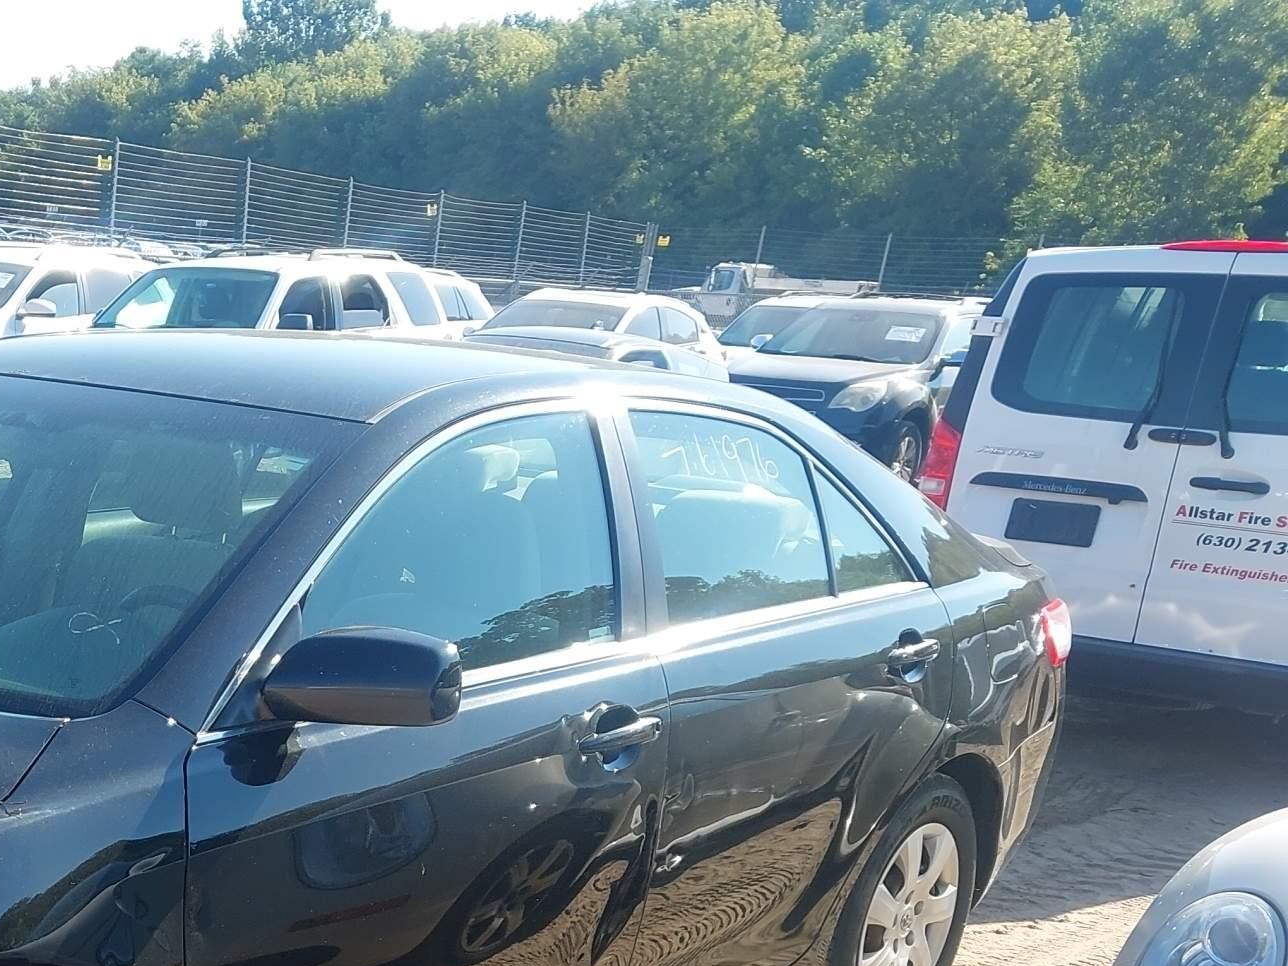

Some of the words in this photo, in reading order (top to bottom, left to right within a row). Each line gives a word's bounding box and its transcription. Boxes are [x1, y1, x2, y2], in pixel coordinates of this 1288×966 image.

[1175, 504, 1234, 522] Allstar
[1237, 511, 1272, 526] Fire
[1196, 533, 1242, 551] (630)
[1244, 538, 1288, 555] 213
[1170, 558, 1199, 571] Fire
[1201, 563, 1288, 583] Extinguishe
